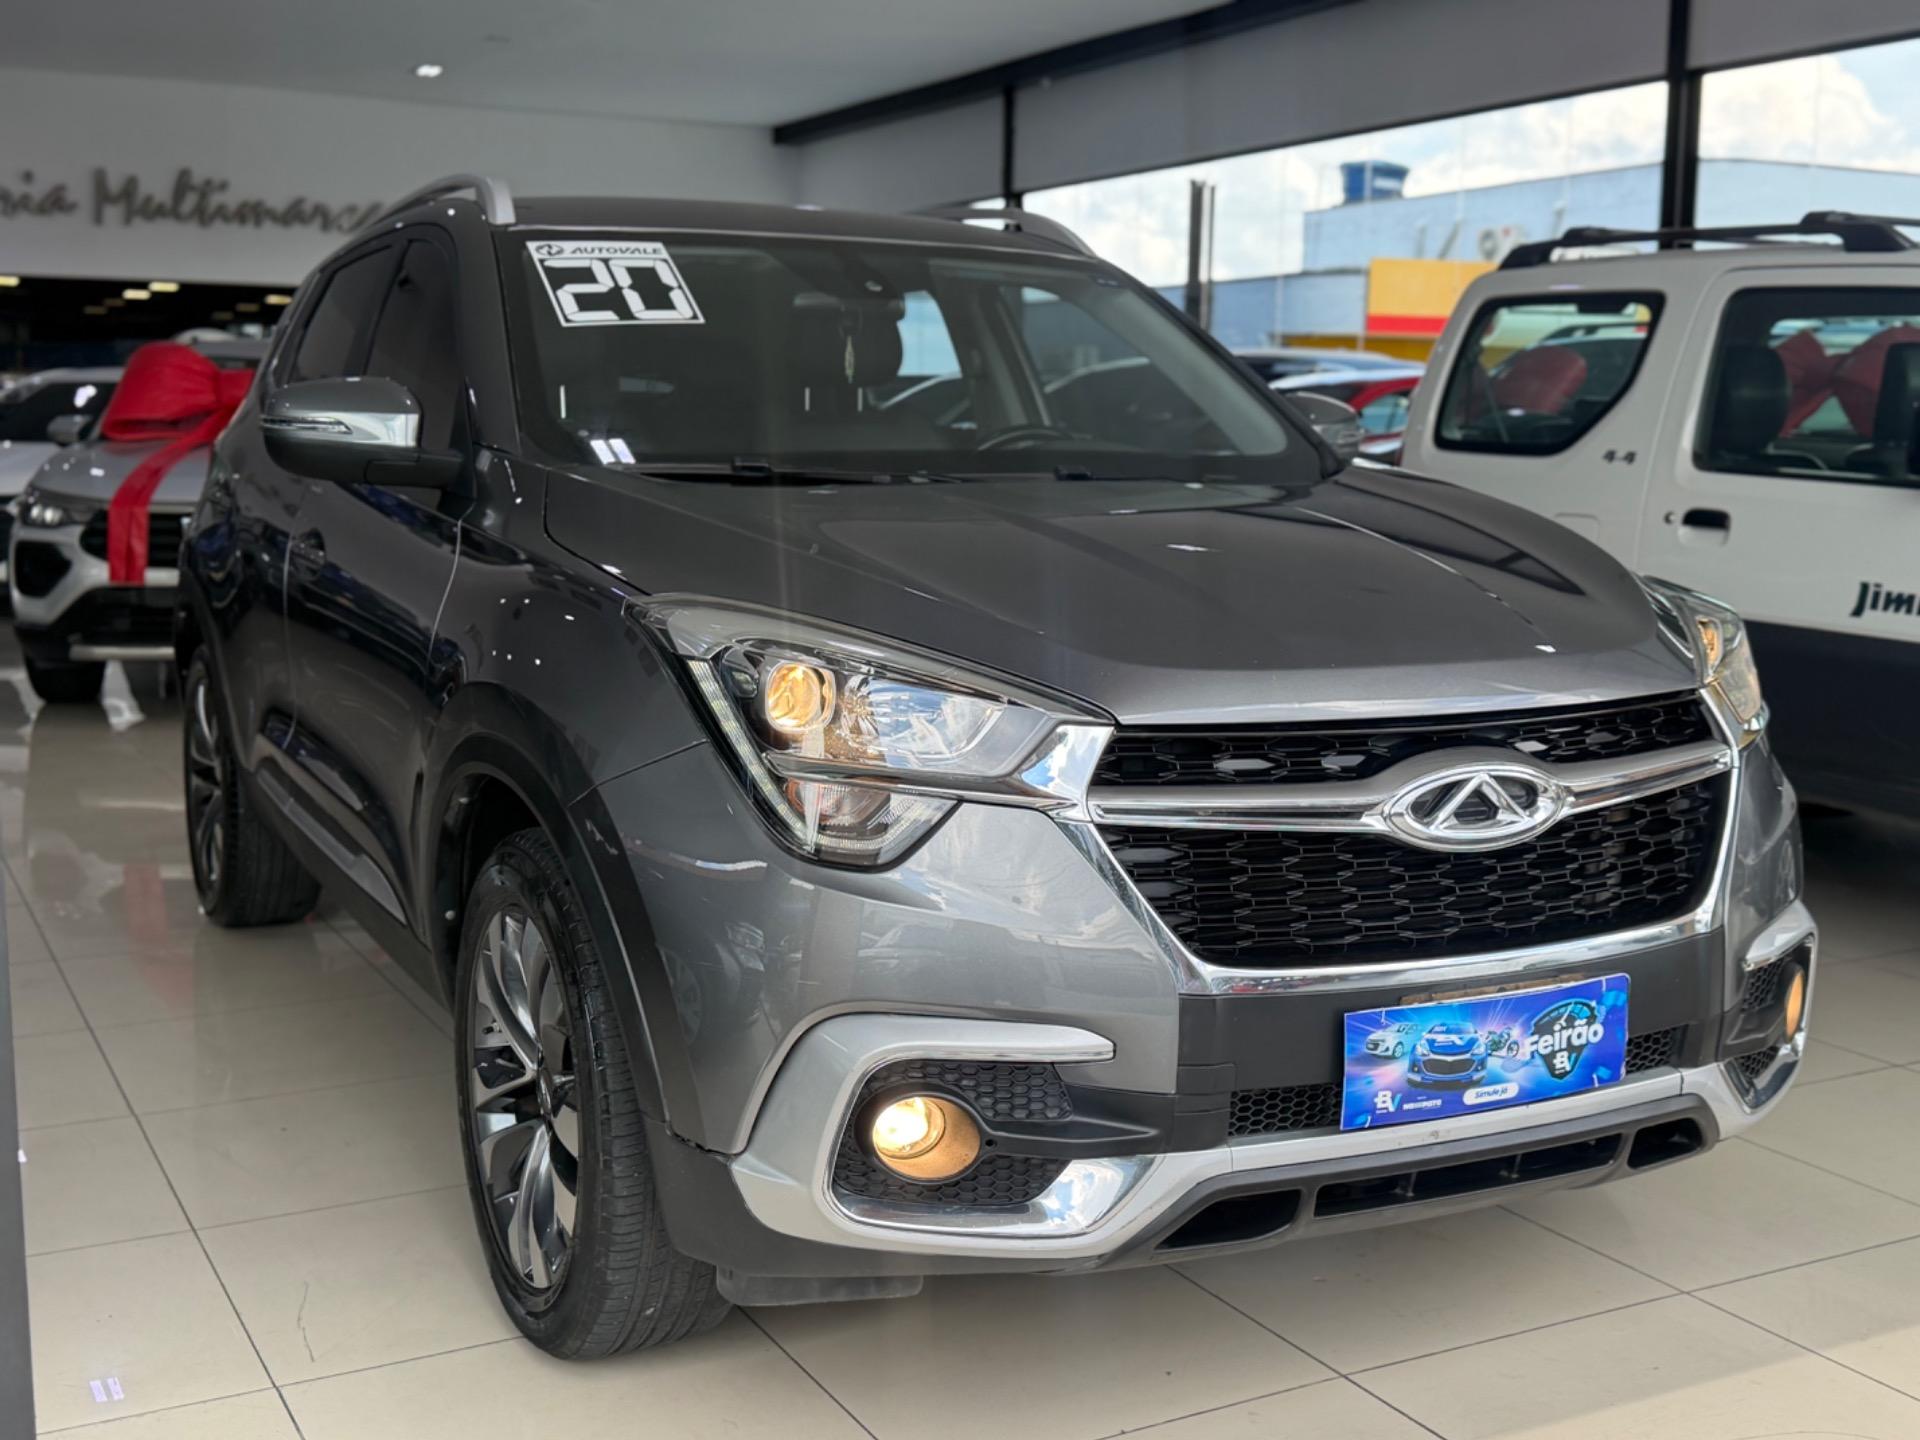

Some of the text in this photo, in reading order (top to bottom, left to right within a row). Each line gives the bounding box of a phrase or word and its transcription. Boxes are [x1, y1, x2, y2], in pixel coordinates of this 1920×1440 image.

[571, 247, 662, 255] AUTOVALE
[543, 259, 694, 322] 20
[1849, 581, 1920, 618] Jim
[1522, 1018, 1604, 1060] Feirão
